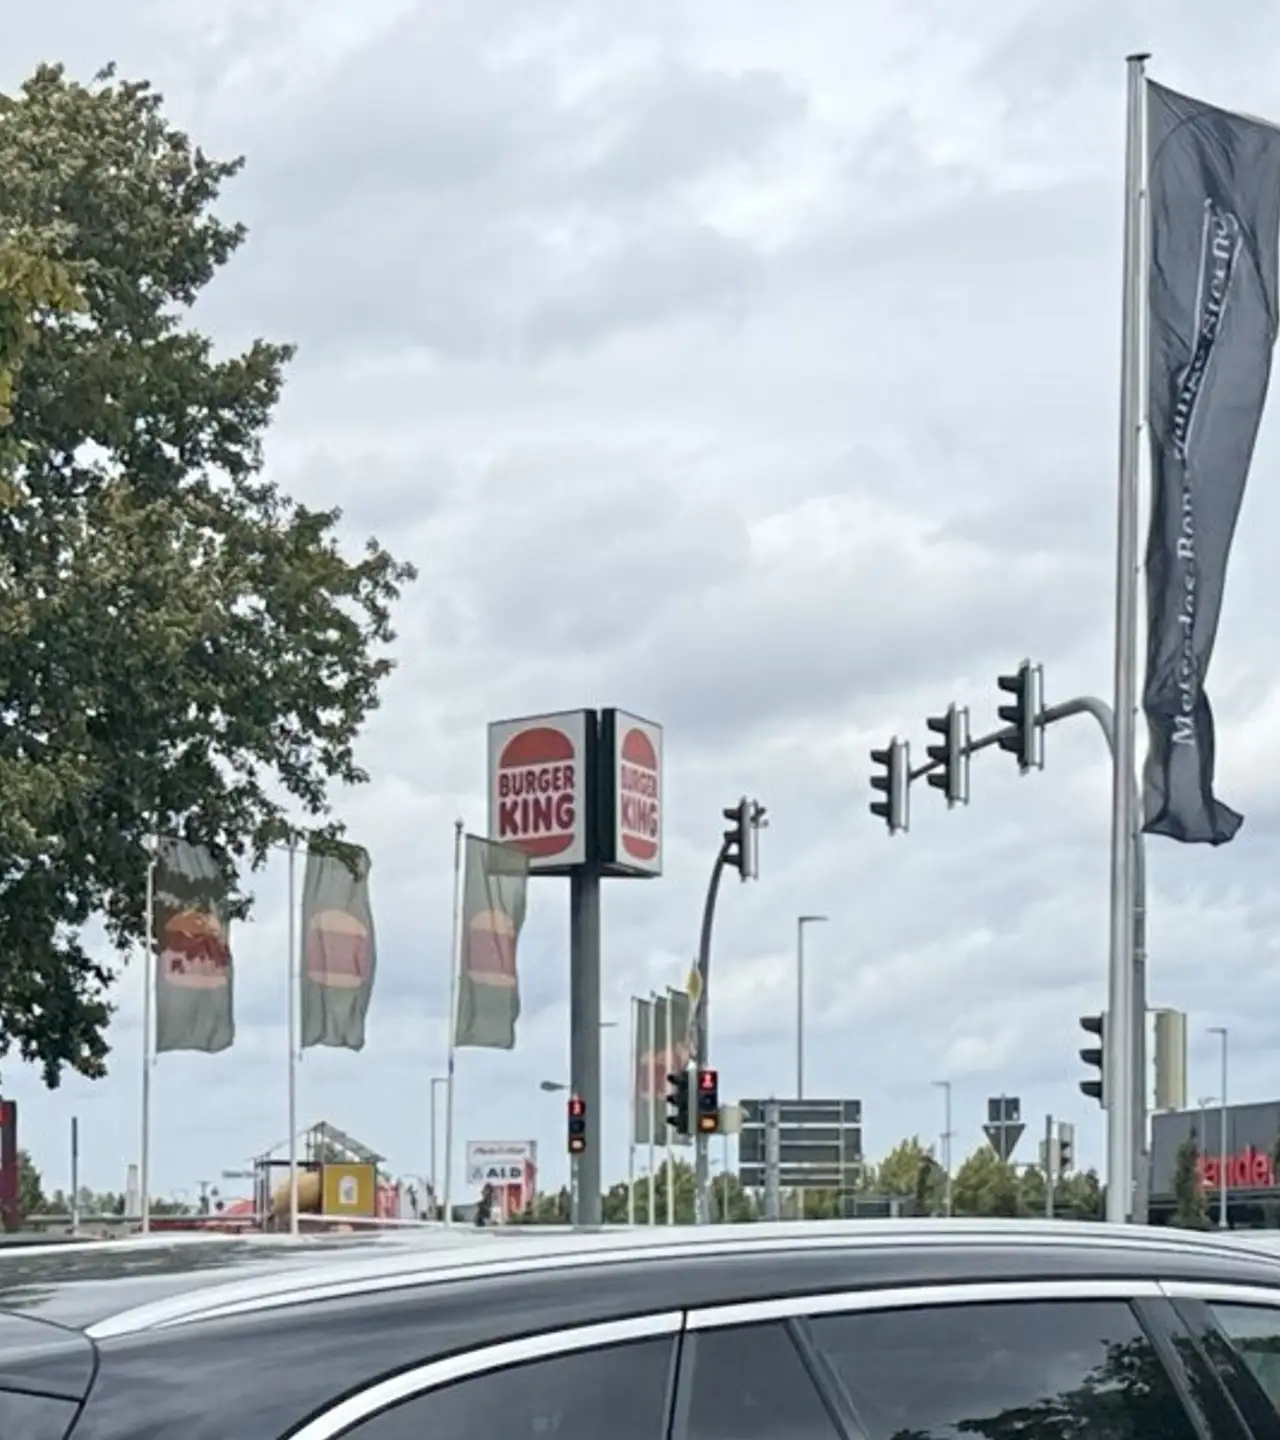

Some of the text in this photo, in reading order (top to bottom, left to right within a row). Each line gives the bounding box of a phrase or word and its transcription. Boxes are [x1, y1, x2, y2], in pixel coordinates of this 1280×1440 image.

[498, 764, 575, 798] BURGER
[621, 763, 658, 799] BURGER
[498, 794, 576, 836] KING
[621, 792, 658, 838] KING
